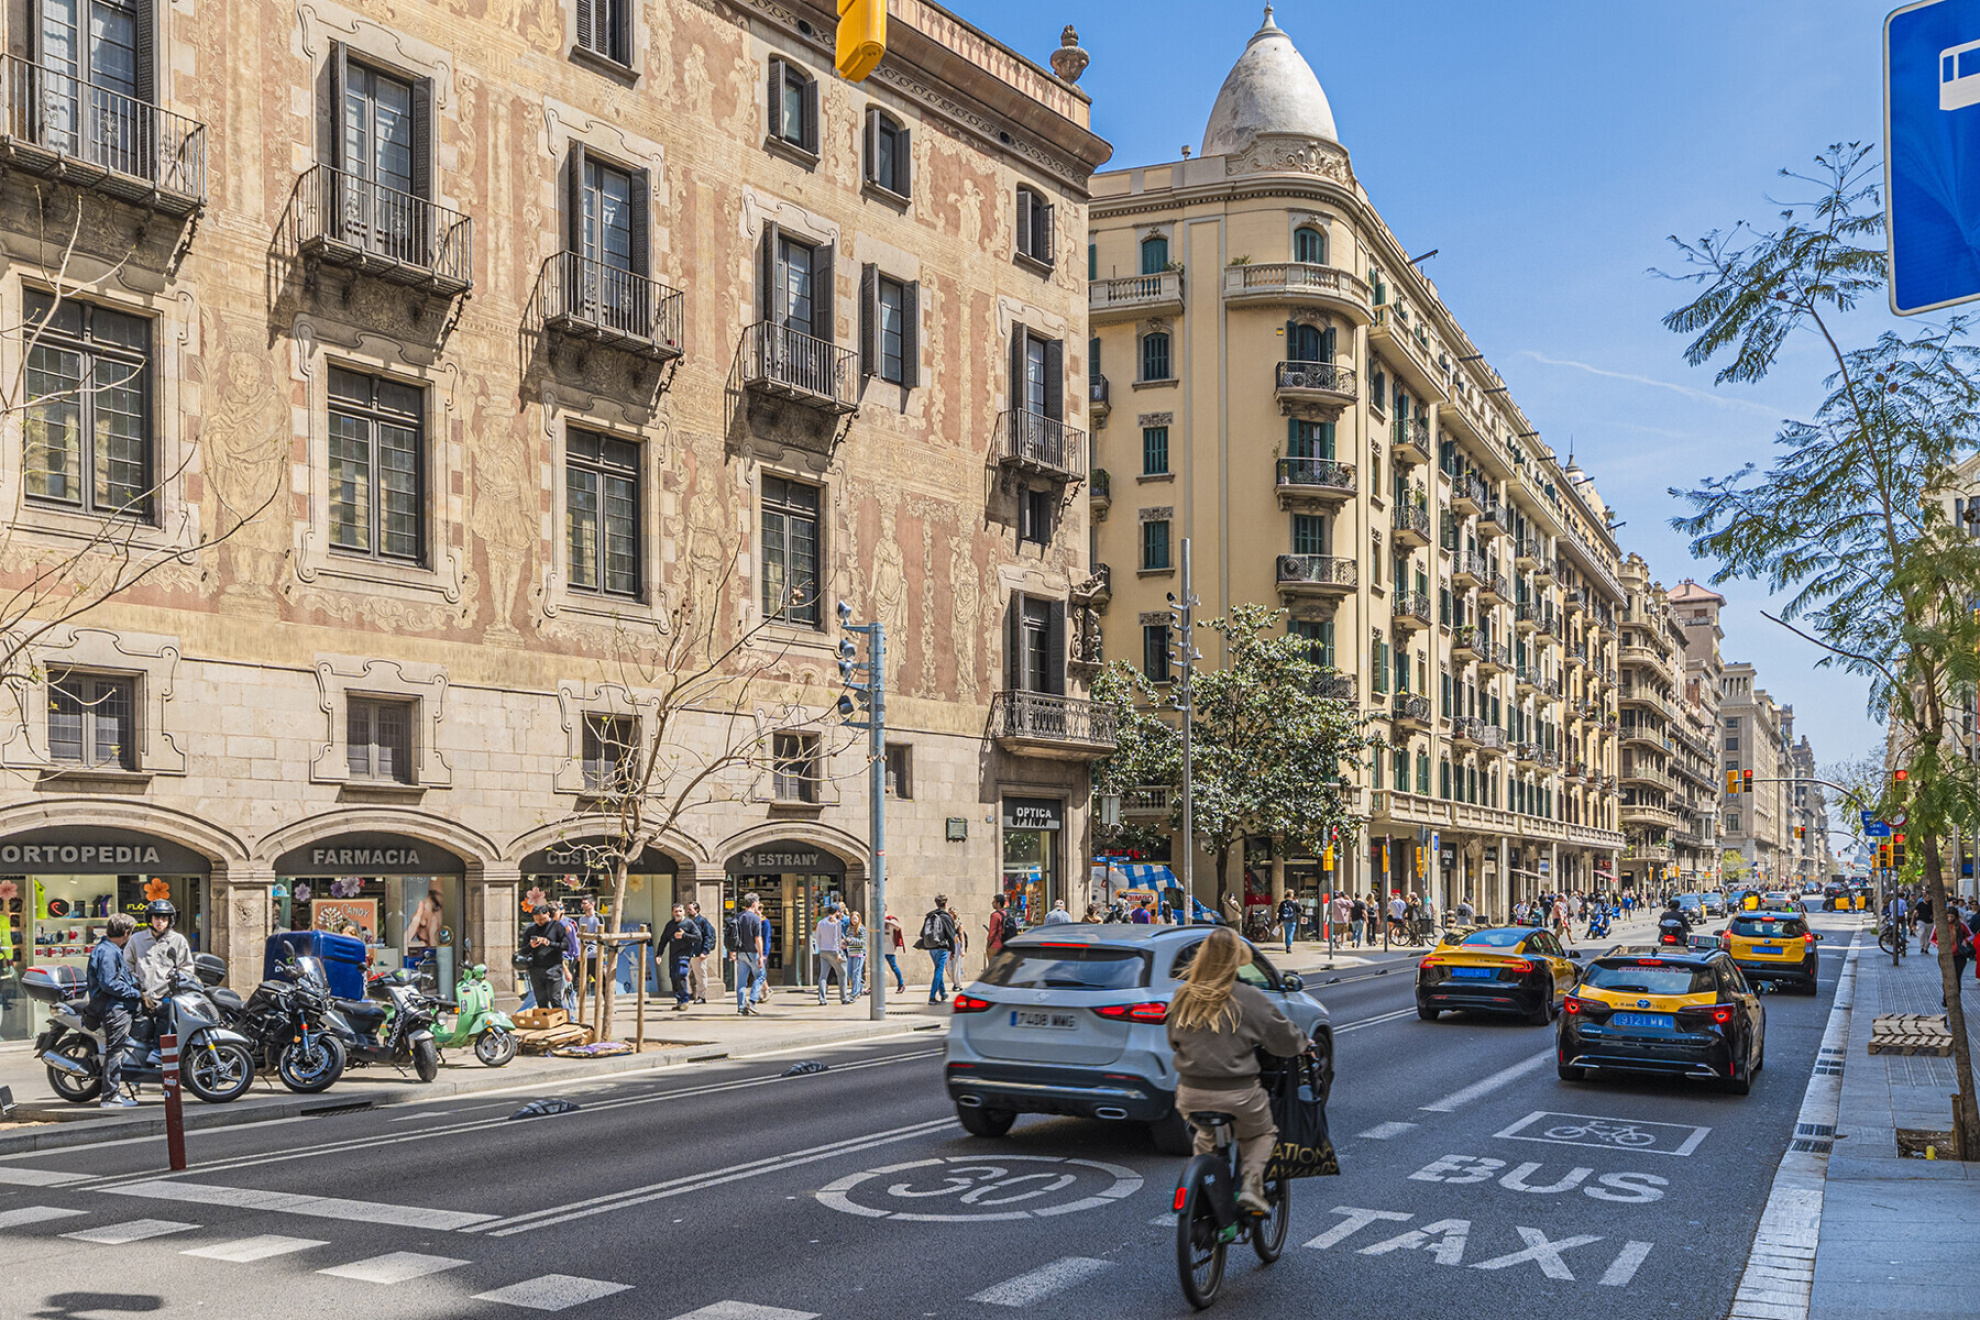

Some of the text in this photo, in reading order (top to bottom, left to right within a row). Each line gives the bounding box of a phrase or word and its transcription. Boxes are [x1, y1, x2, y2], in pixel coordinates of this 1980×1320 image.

[1016, 807, 1053, 818] OPTICA
[2, 846, 160, 863] ORTOPEDIA
[313, 849, 420, 865] FARMACIA
[758, 853, 819, 866] ESTRANY
[341, 903, 370, 919] CANDY
[1621, 1014, 1647, 1025] 9121
[887, 1166, 1077, 1205] 30
[1407, 1154, 1669, 1203] BUS
[1302, 1206, 1655, 1287] TAXI
